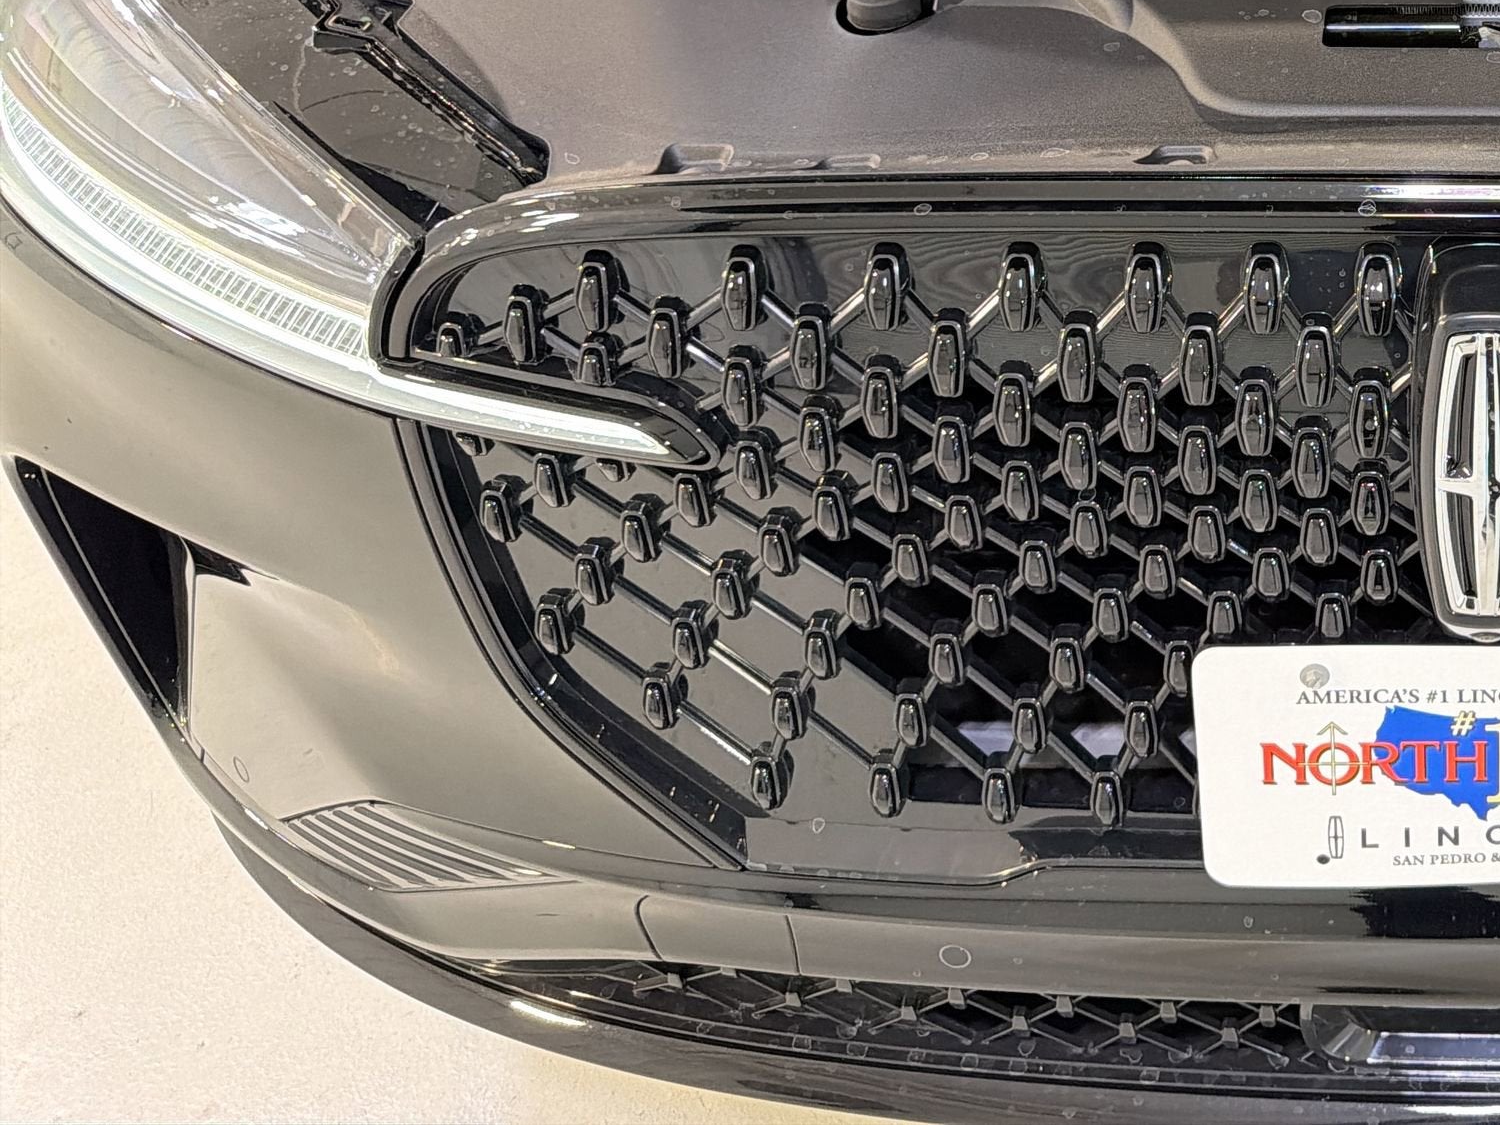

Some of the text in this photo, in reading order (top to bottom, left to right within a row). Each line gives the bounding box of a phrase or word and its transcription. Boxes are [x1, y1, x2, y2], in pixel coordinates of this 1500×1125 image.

[1296, 689, 1420, 704] AMERICA'S
[1426, 689, 1450, 704] #1
[1260, 741, 1489, 786] NORTH
[1393, 855, 1425, 866] SAN
[1430, 852, 1487, 865] PEDRO
